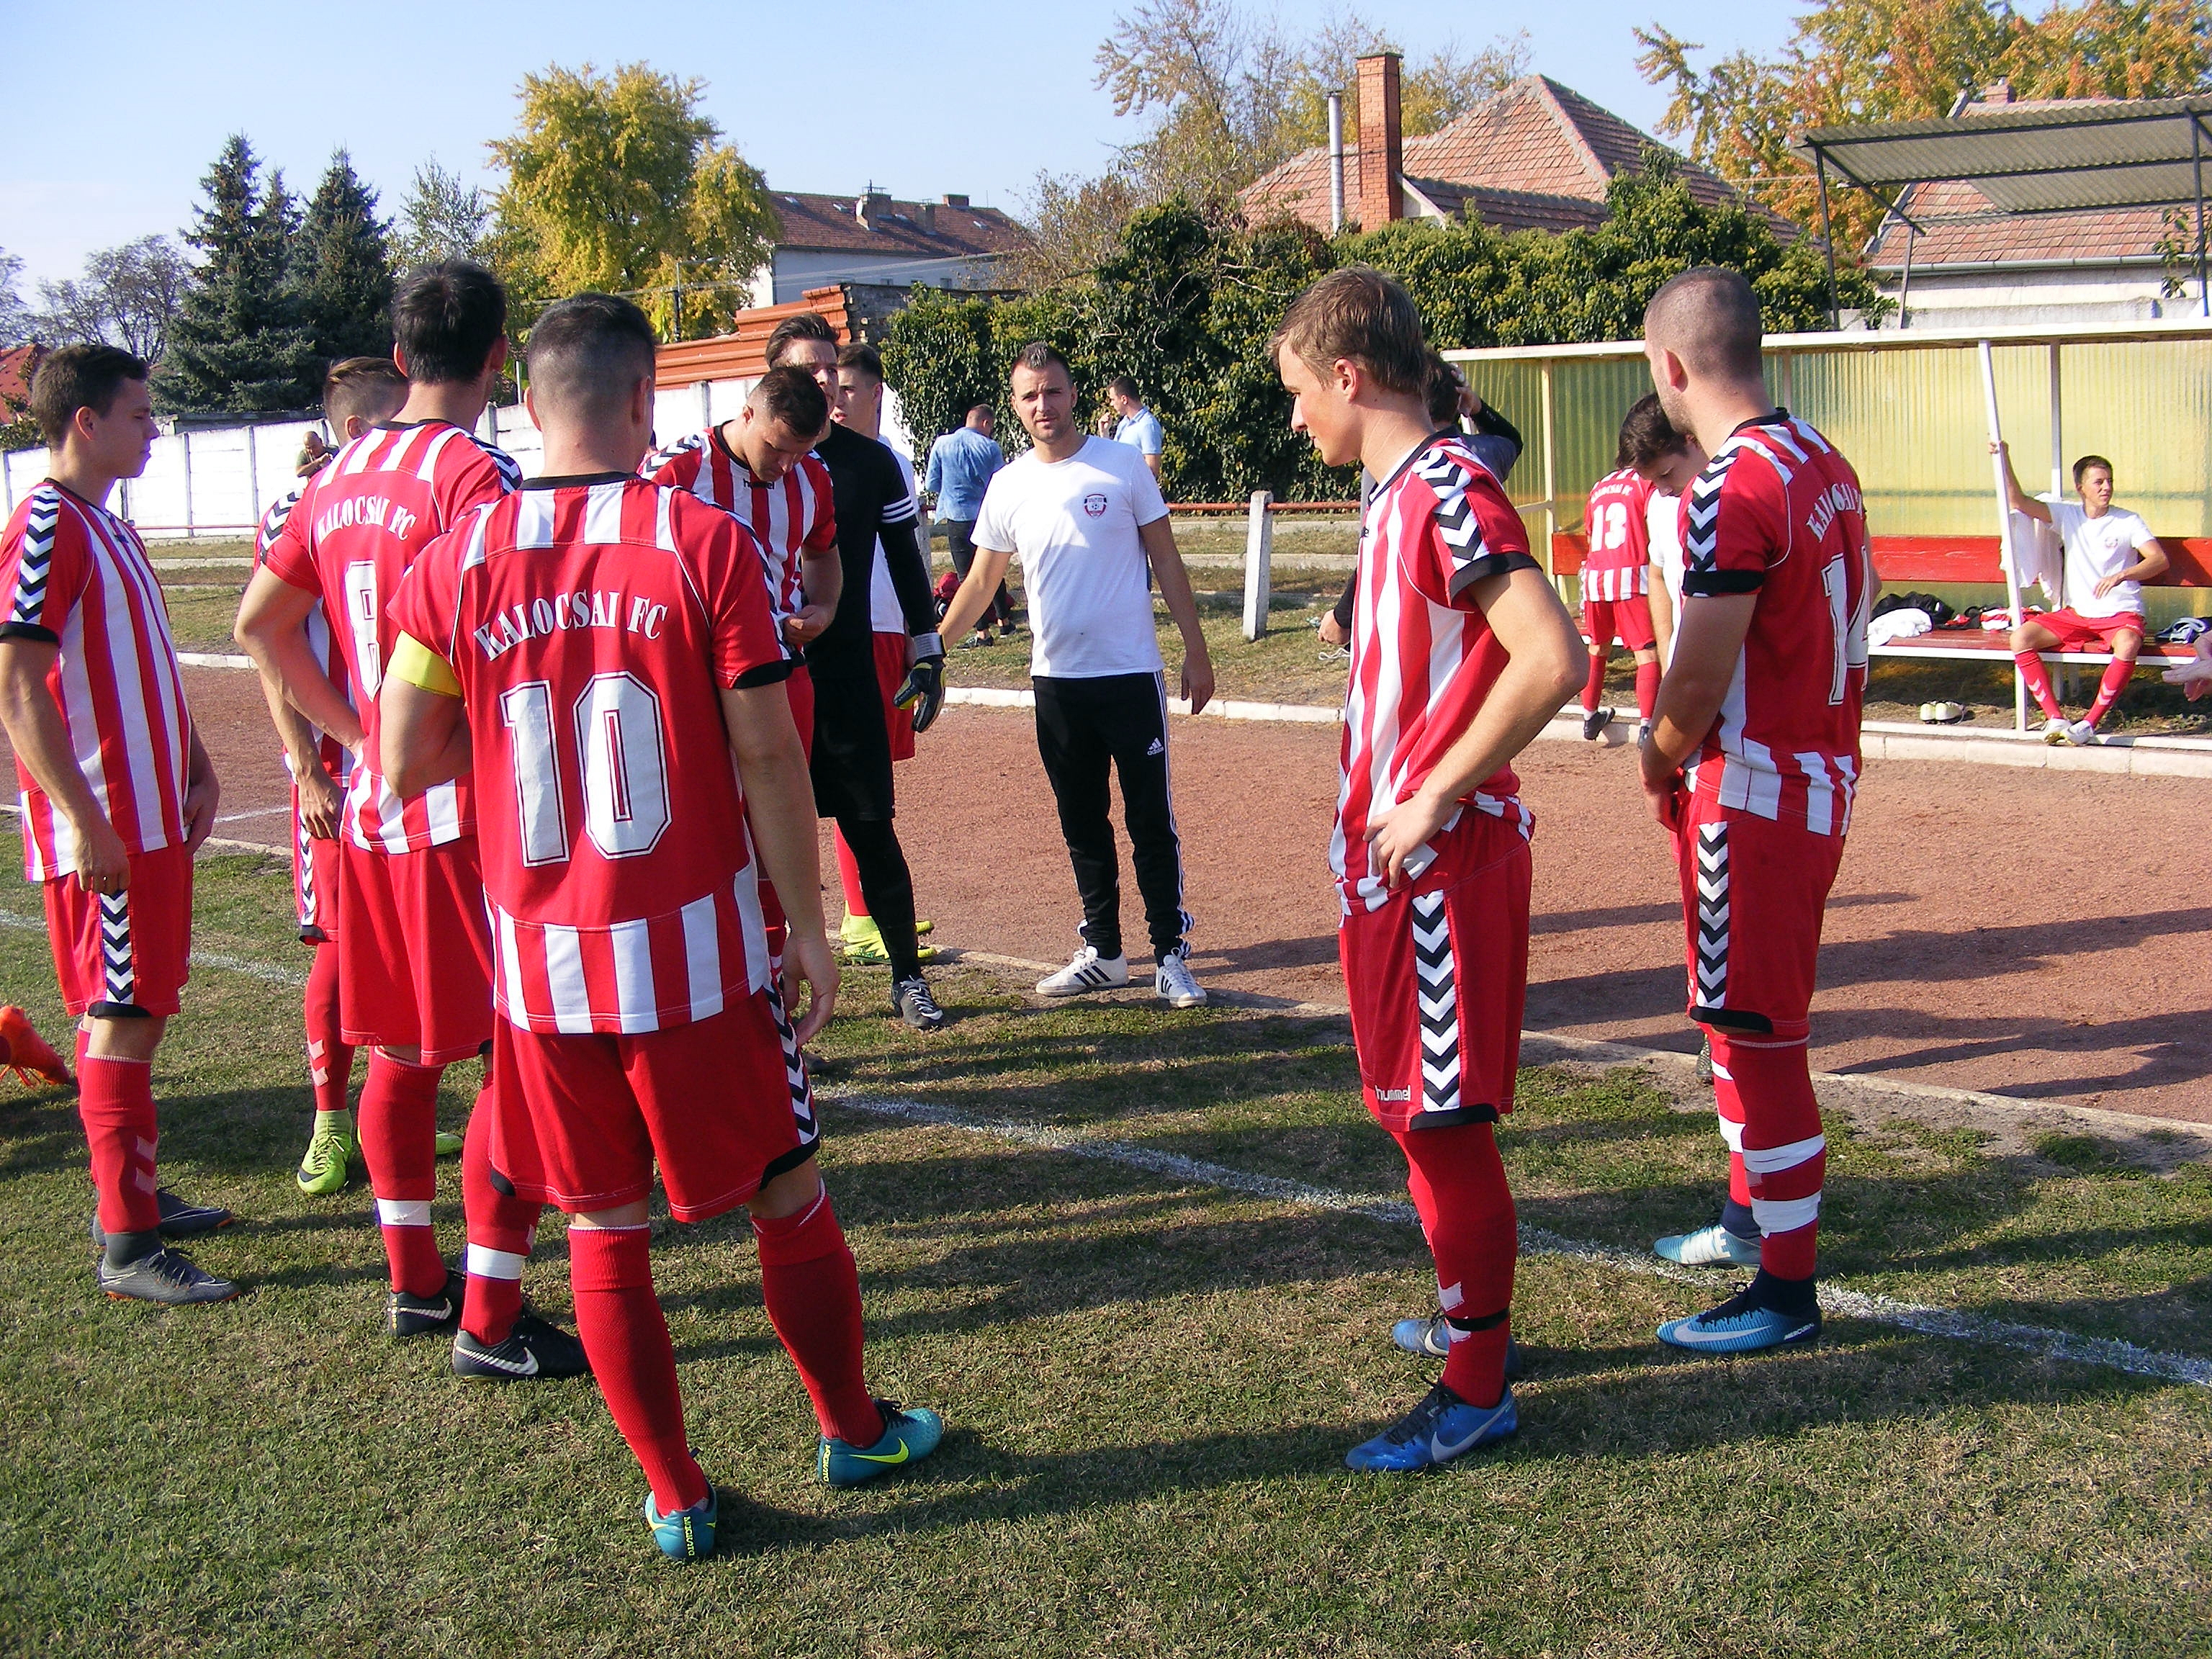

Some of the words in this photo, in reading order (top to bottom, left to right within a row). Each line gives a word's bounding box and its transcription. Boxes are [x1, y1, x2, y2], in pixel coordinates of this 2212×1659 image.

[318, 495, 390, 544] KALOCSAI
[387, 505, 418, 541] FC
[1591, 502, 1627, 553] 13
[345, 559, 382, 703] 8
[473, 589, 620, 661] KALOCSAI
[626, 595, 668, 639] FC
[1820, 545, 1870, 706] 14
[498, 670, 673, 868] 10
[1375, 1084, 1411, 1102] hummel
